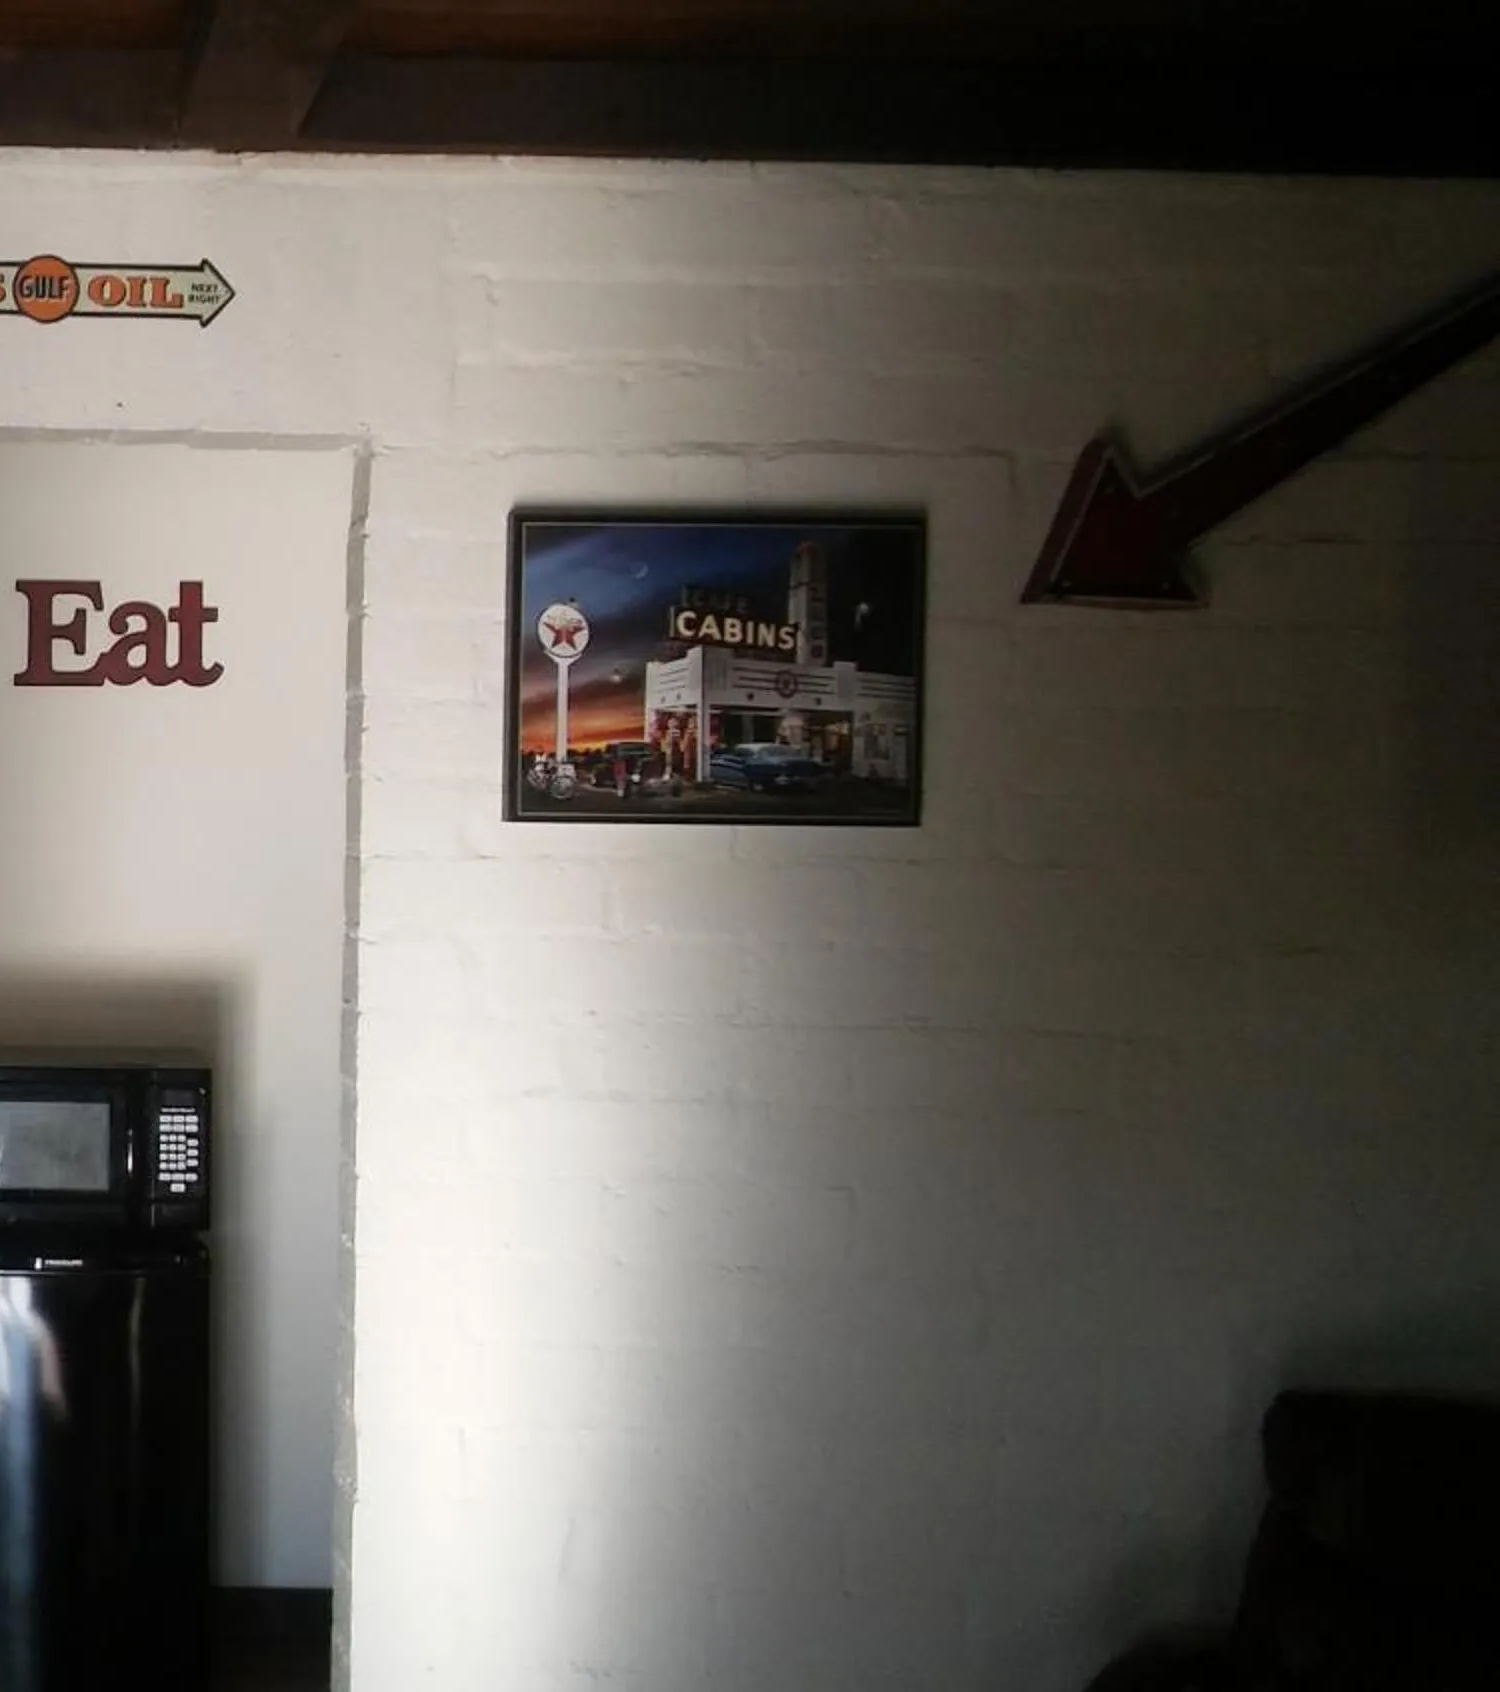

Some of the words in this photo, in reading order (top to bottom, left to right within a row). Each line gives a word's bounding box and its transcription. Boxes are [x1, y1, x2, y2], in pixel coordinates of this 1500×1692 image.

[19, 275, 71, 301] GULF
[87, 275, 185, 309] OIL
[13, 579, 225, 687] Eat
[675, 610, 796, 650] CABINS
